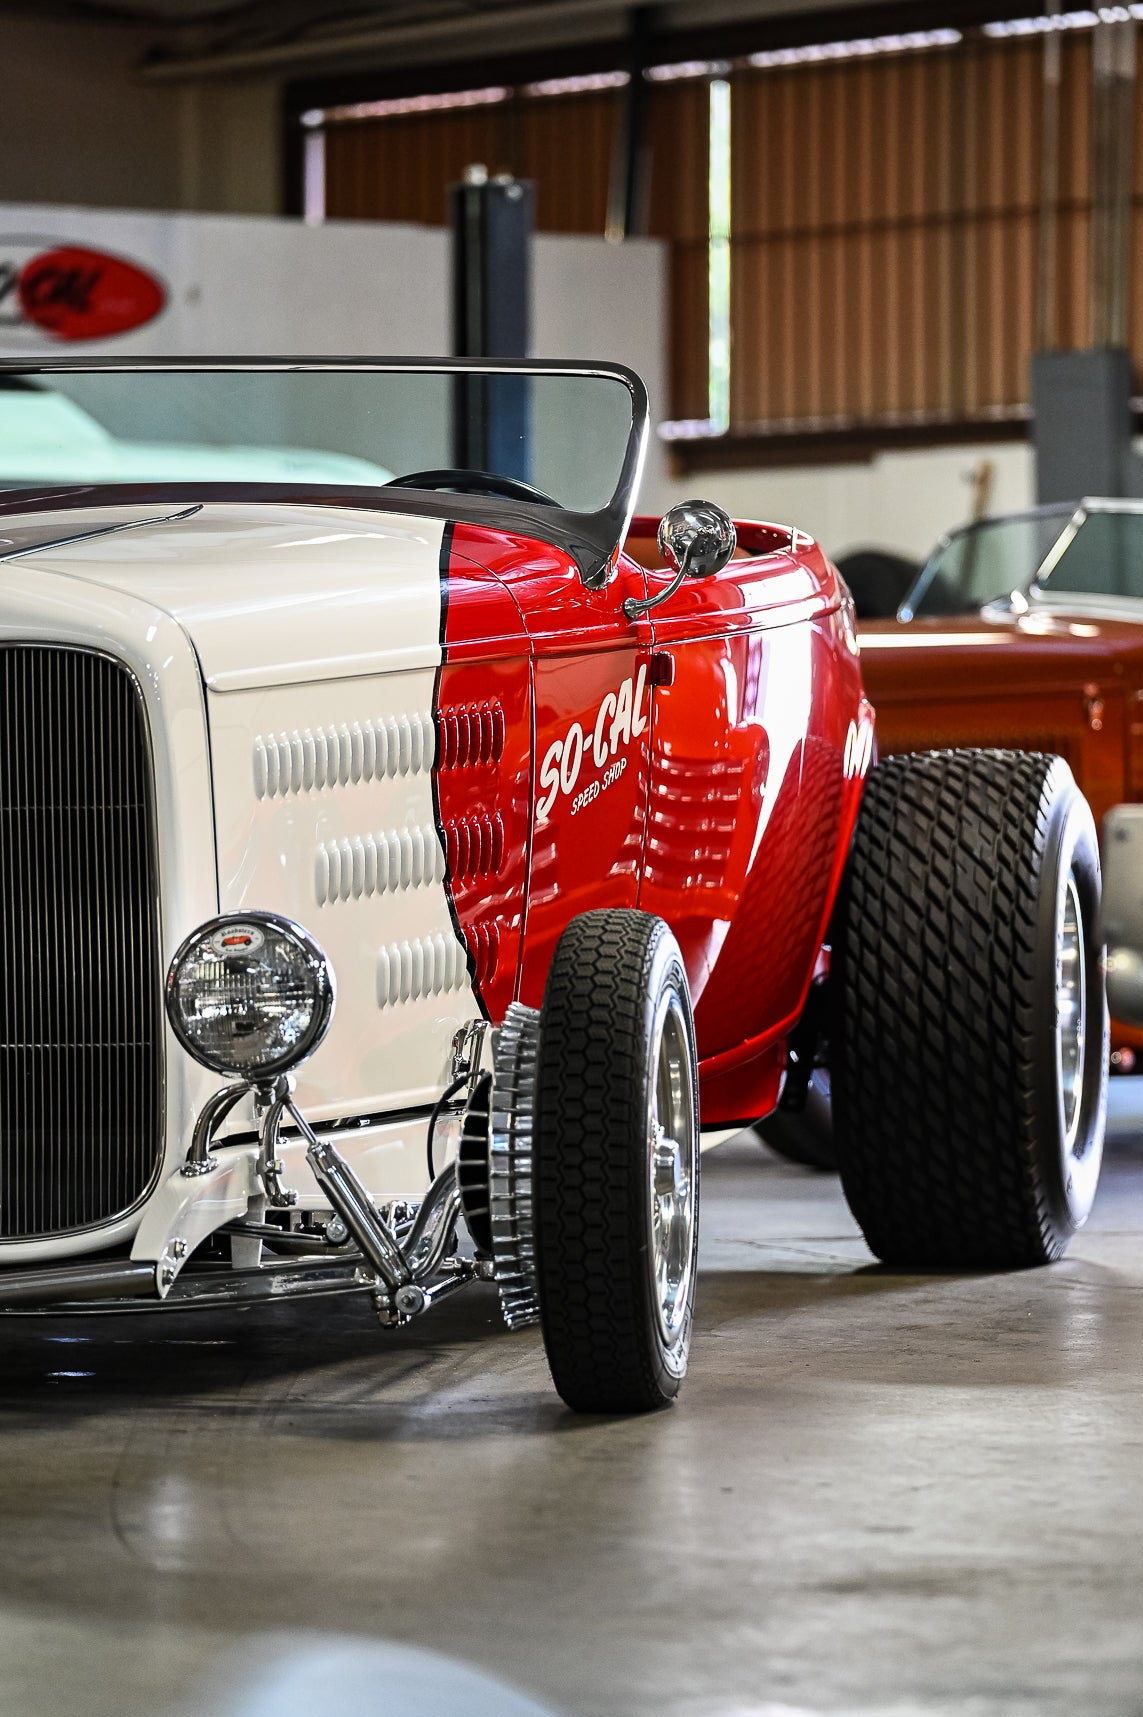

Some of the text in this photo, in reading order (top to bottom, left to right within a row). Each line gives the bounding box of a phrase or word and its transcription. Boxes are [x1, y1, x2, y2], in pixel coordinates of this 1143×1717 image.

[535, 663, 647, 819] SO-CAL
[570, 757, 627, 816] SPEED SHOP
